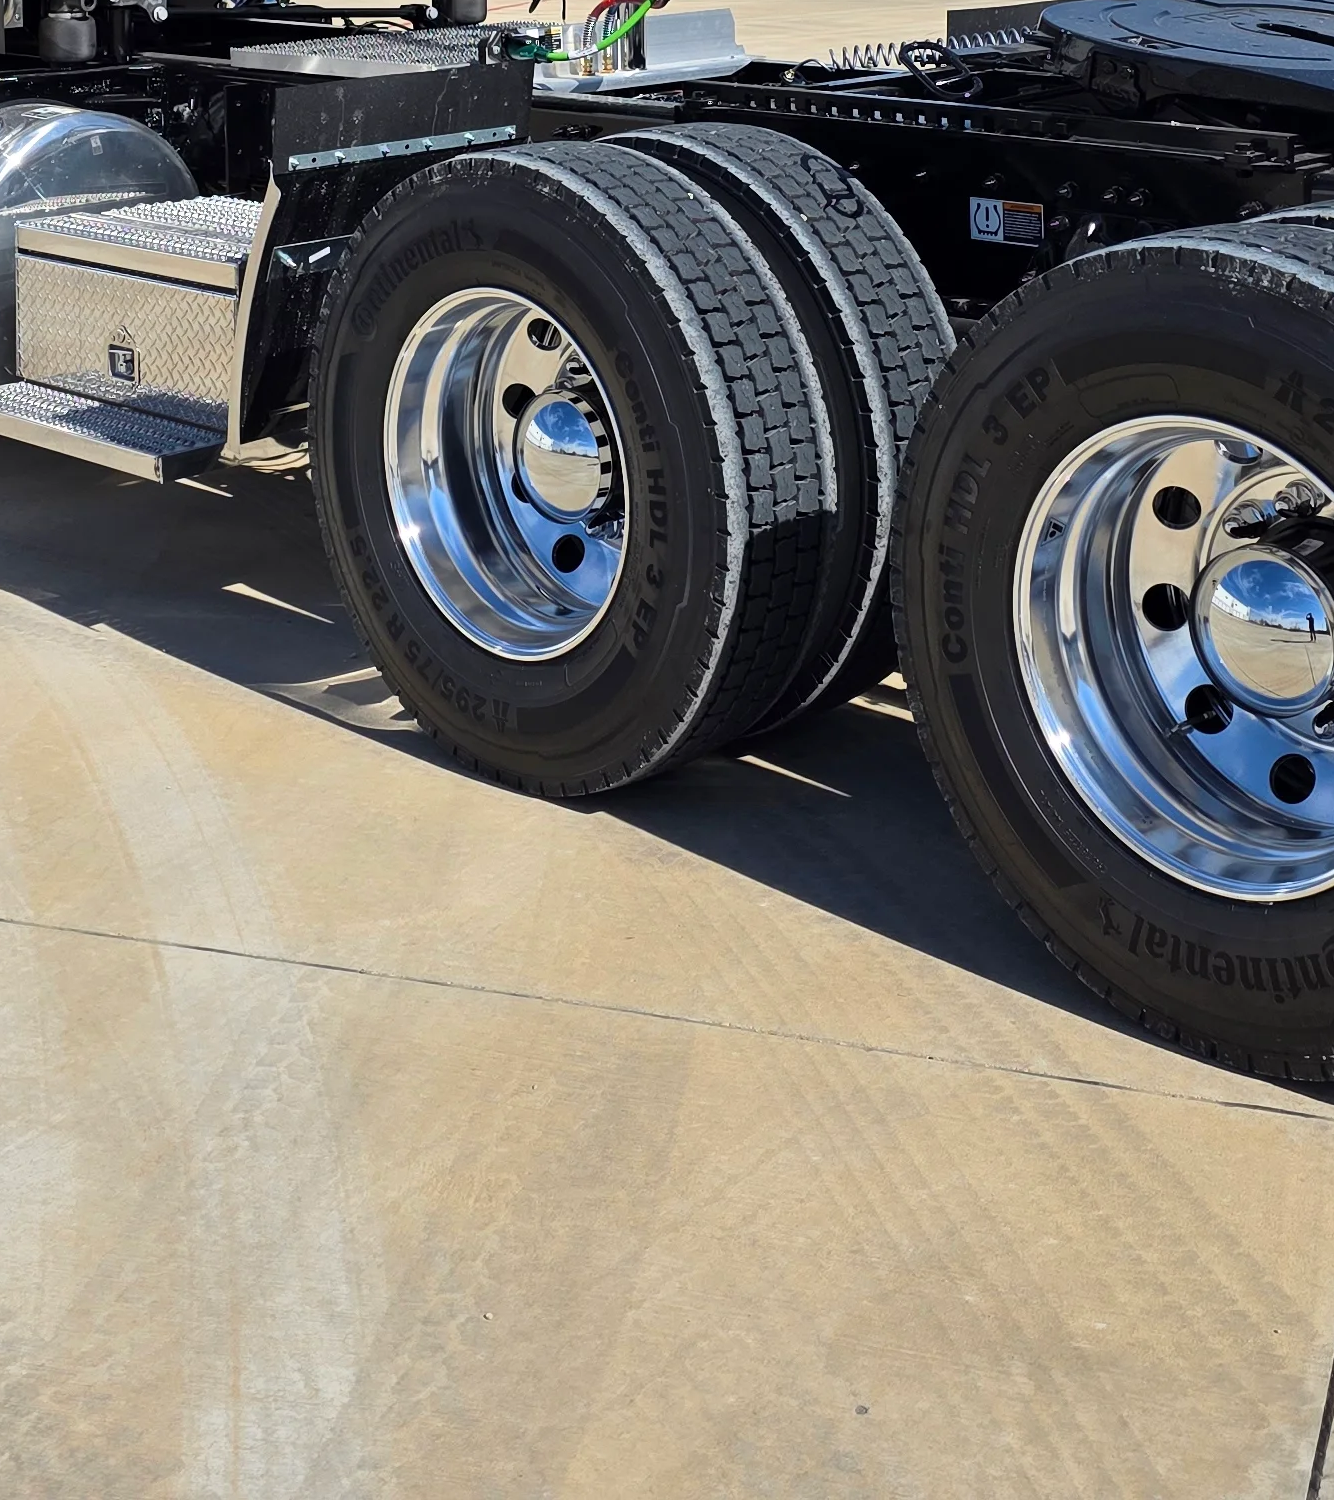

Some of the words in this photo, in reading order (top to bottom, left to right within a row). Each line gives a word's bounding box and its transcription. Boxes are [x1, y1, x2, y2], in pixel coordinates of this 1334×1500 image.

[351, 218, 462, 340] Continental
[614, 350, 661, 453] Conti
[981, 413, 1009, 447] 3
[1004, 365, 1051, 421] EP
[645, 467, 669, 550] HDL
[943, 451, 993, 536] HDL
[349, 534, 390, 612] 22.5
[645, 563, 665, 590] 3
[938, 540, 969, 664] Conti
[384, 611, 406, 642] R
[631, 596, 658, 651] EP
[403, 638, 488, 723] 295/75
